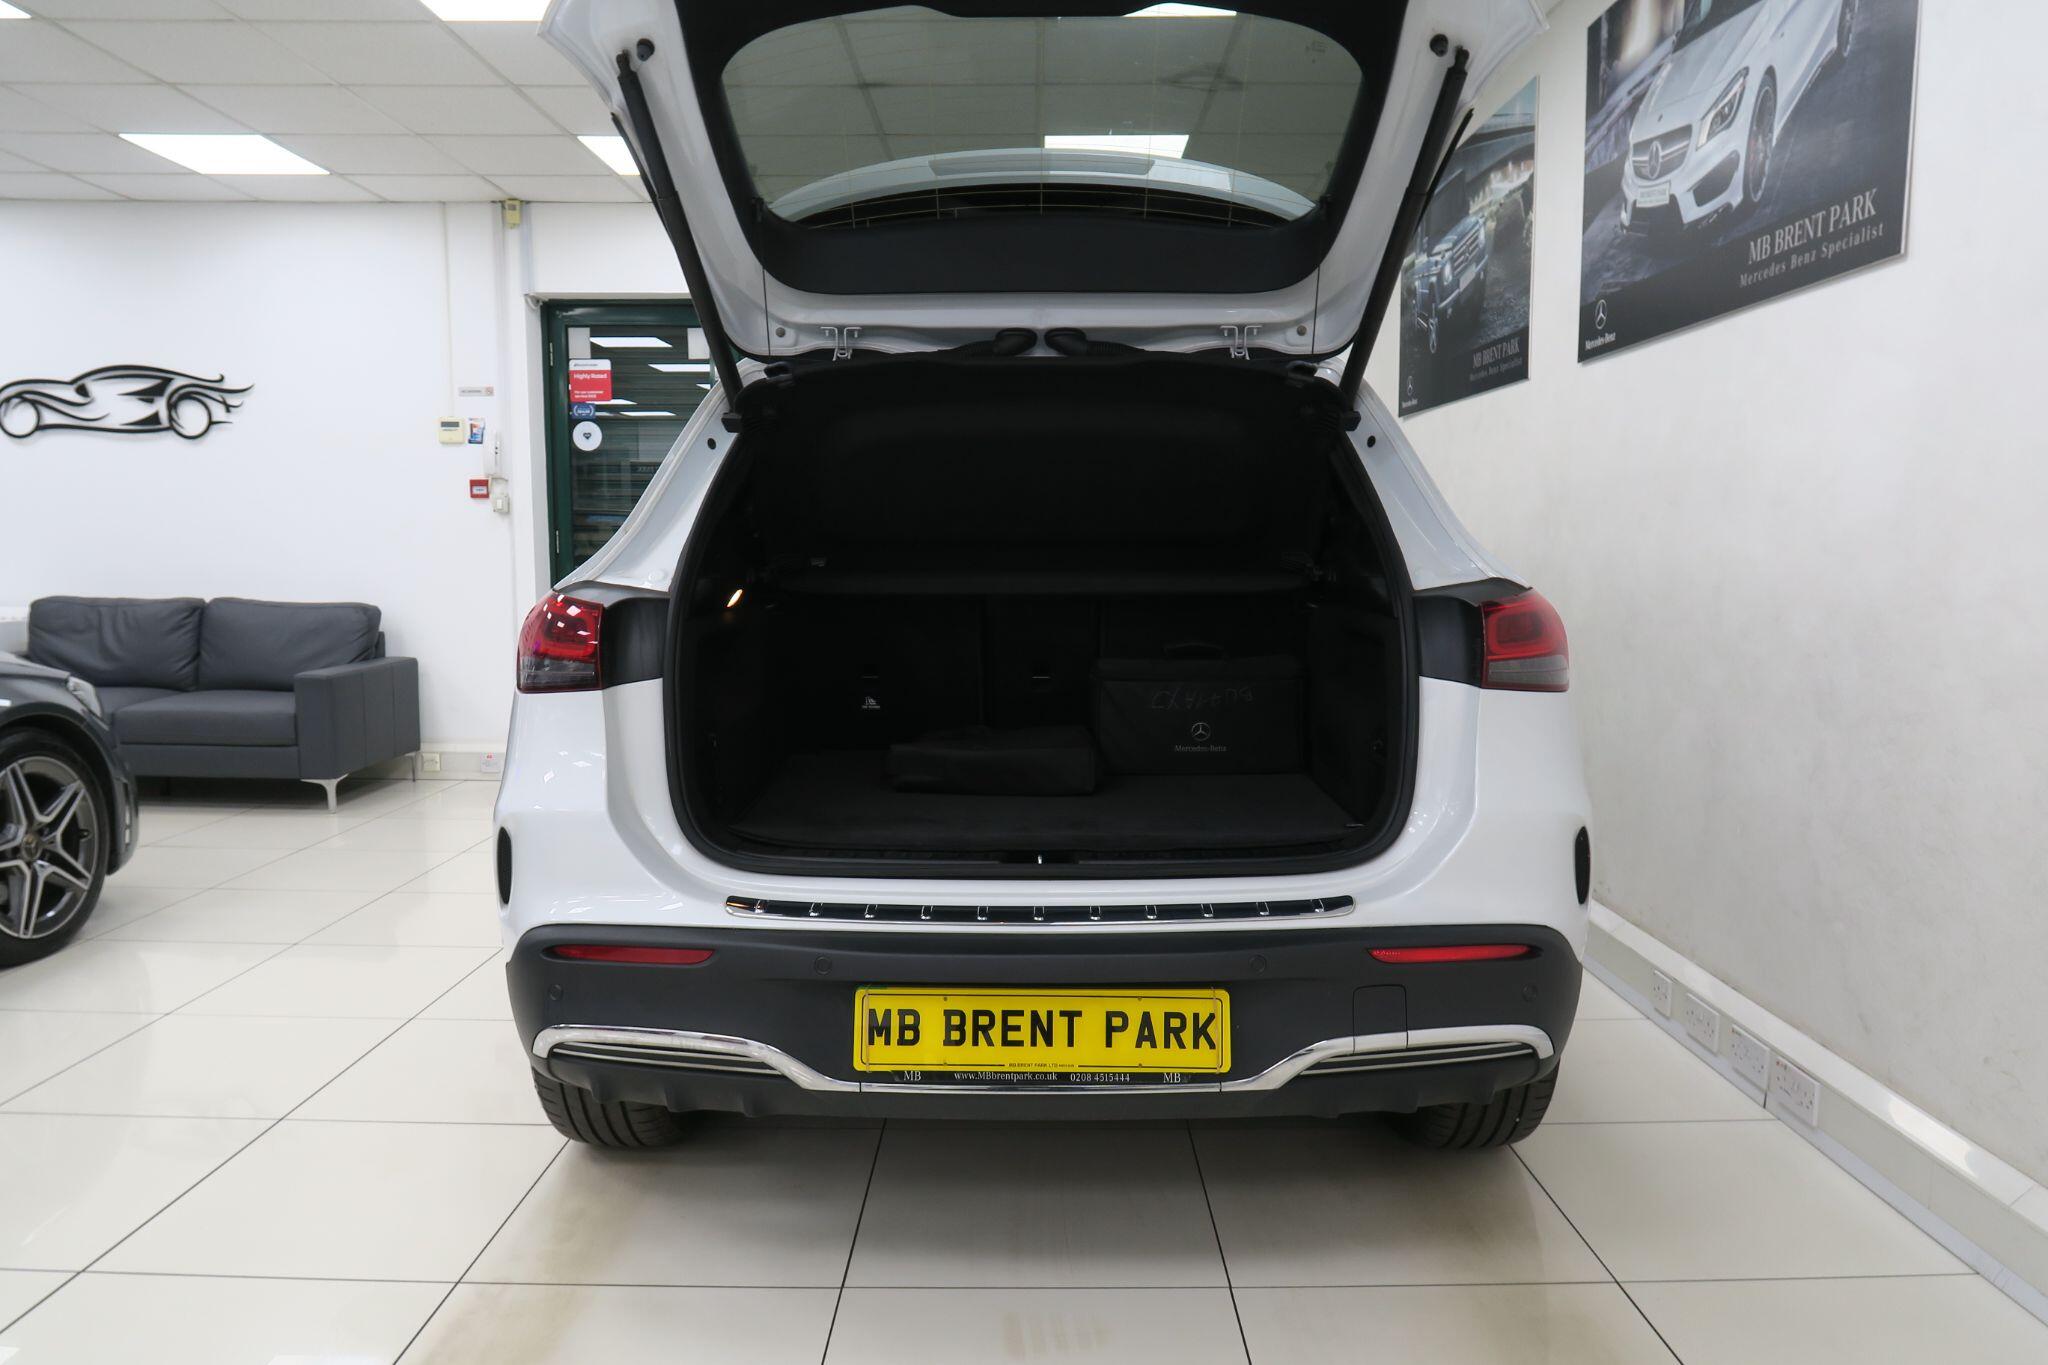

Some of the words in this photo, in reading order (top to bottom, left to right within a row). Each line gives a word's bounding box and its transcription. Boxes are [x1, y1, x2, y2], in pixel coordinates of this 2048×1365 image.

[1748, 234, 1771, 264] MB
[1774, 210, 1826, 255] BRENT
[1828, 188, 1877, 233] PARK
[1739, 260, 1786, 288] Mercedes
[1790, 249, 1817, 270] Benz
[1821, 223, 1884, 259] Specialist
[1482, 344, 1502, 365] BRENT
[1502, 336, 1521, 358] PARK
[1174, 744, 1227, 753] Mercedes-Benz
[868, 1008, 921, 1047] MB
[943, 1009, 1083, 1048] BRENT
[1105, 1010, 1216, 1050] PARK
[903, 1070, 922, 1081] MB
[954, 1071, 1058, 1083] www.MBbrentpark.co.uk
[1070, 1072, 1092, 1082] 0208
[1093, 1073, 1130, 1082] 4515444
[1163, 1072, 1181, 1083] MB
